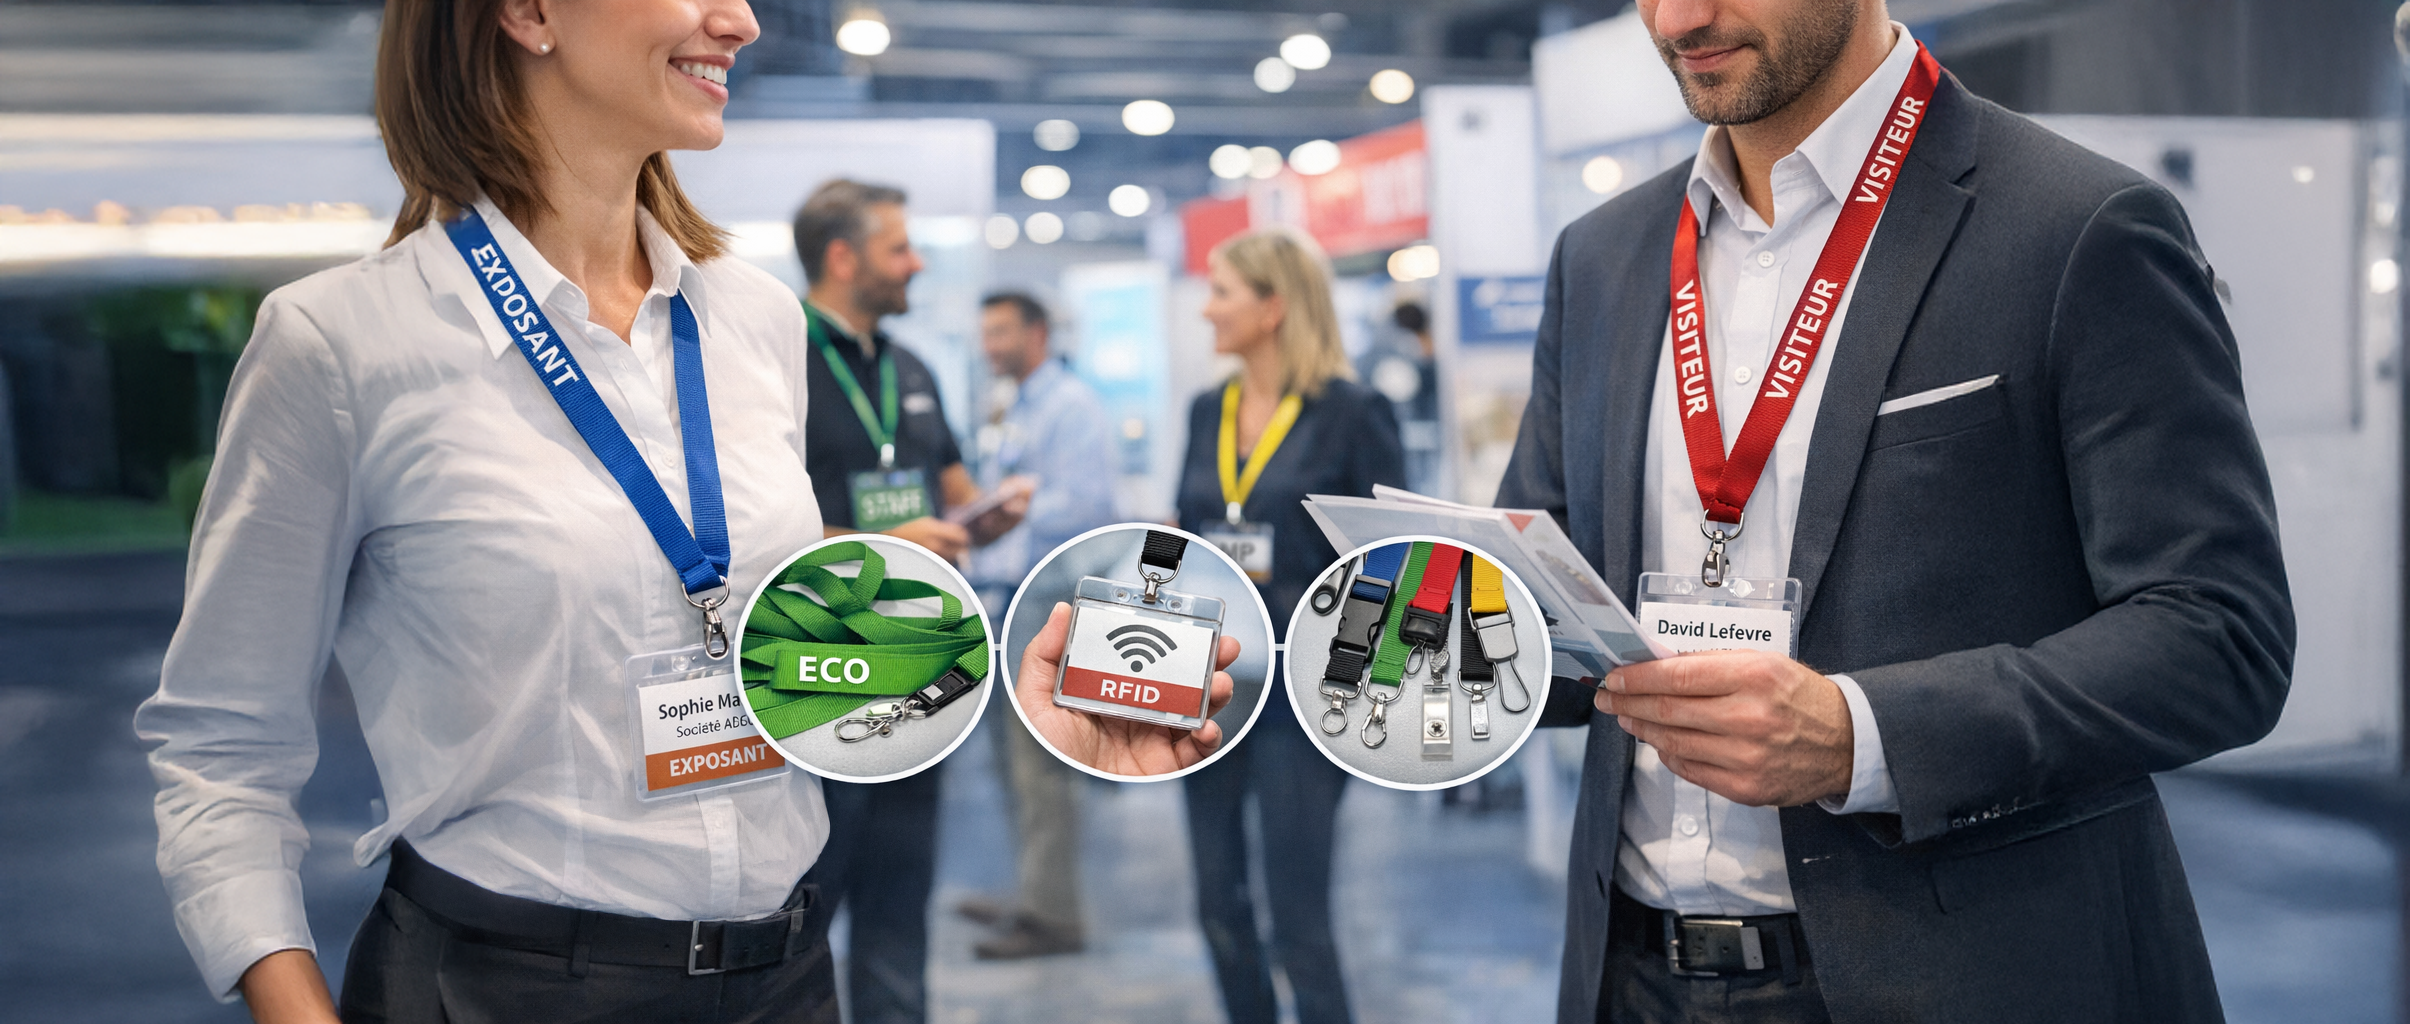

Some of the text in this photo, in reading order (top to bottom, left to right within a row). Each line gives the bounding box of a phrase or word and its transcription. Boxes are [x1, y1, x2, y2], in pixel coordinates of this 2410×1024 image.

[1855, 96, 1925, 203] VISITEUR
[1676, 279, 1709, 419] VISITEUR
[1764, 278, 1839, 399] VISITEUR
[1657, 619, 1772, 642] David Lefevre
[799, 655, 870, 684] ECO
[1100, 678, 1161, 704] RFID
[658, 697, 714, 720] Sophie
[669, 743, 768, 777] EXPOSANT
